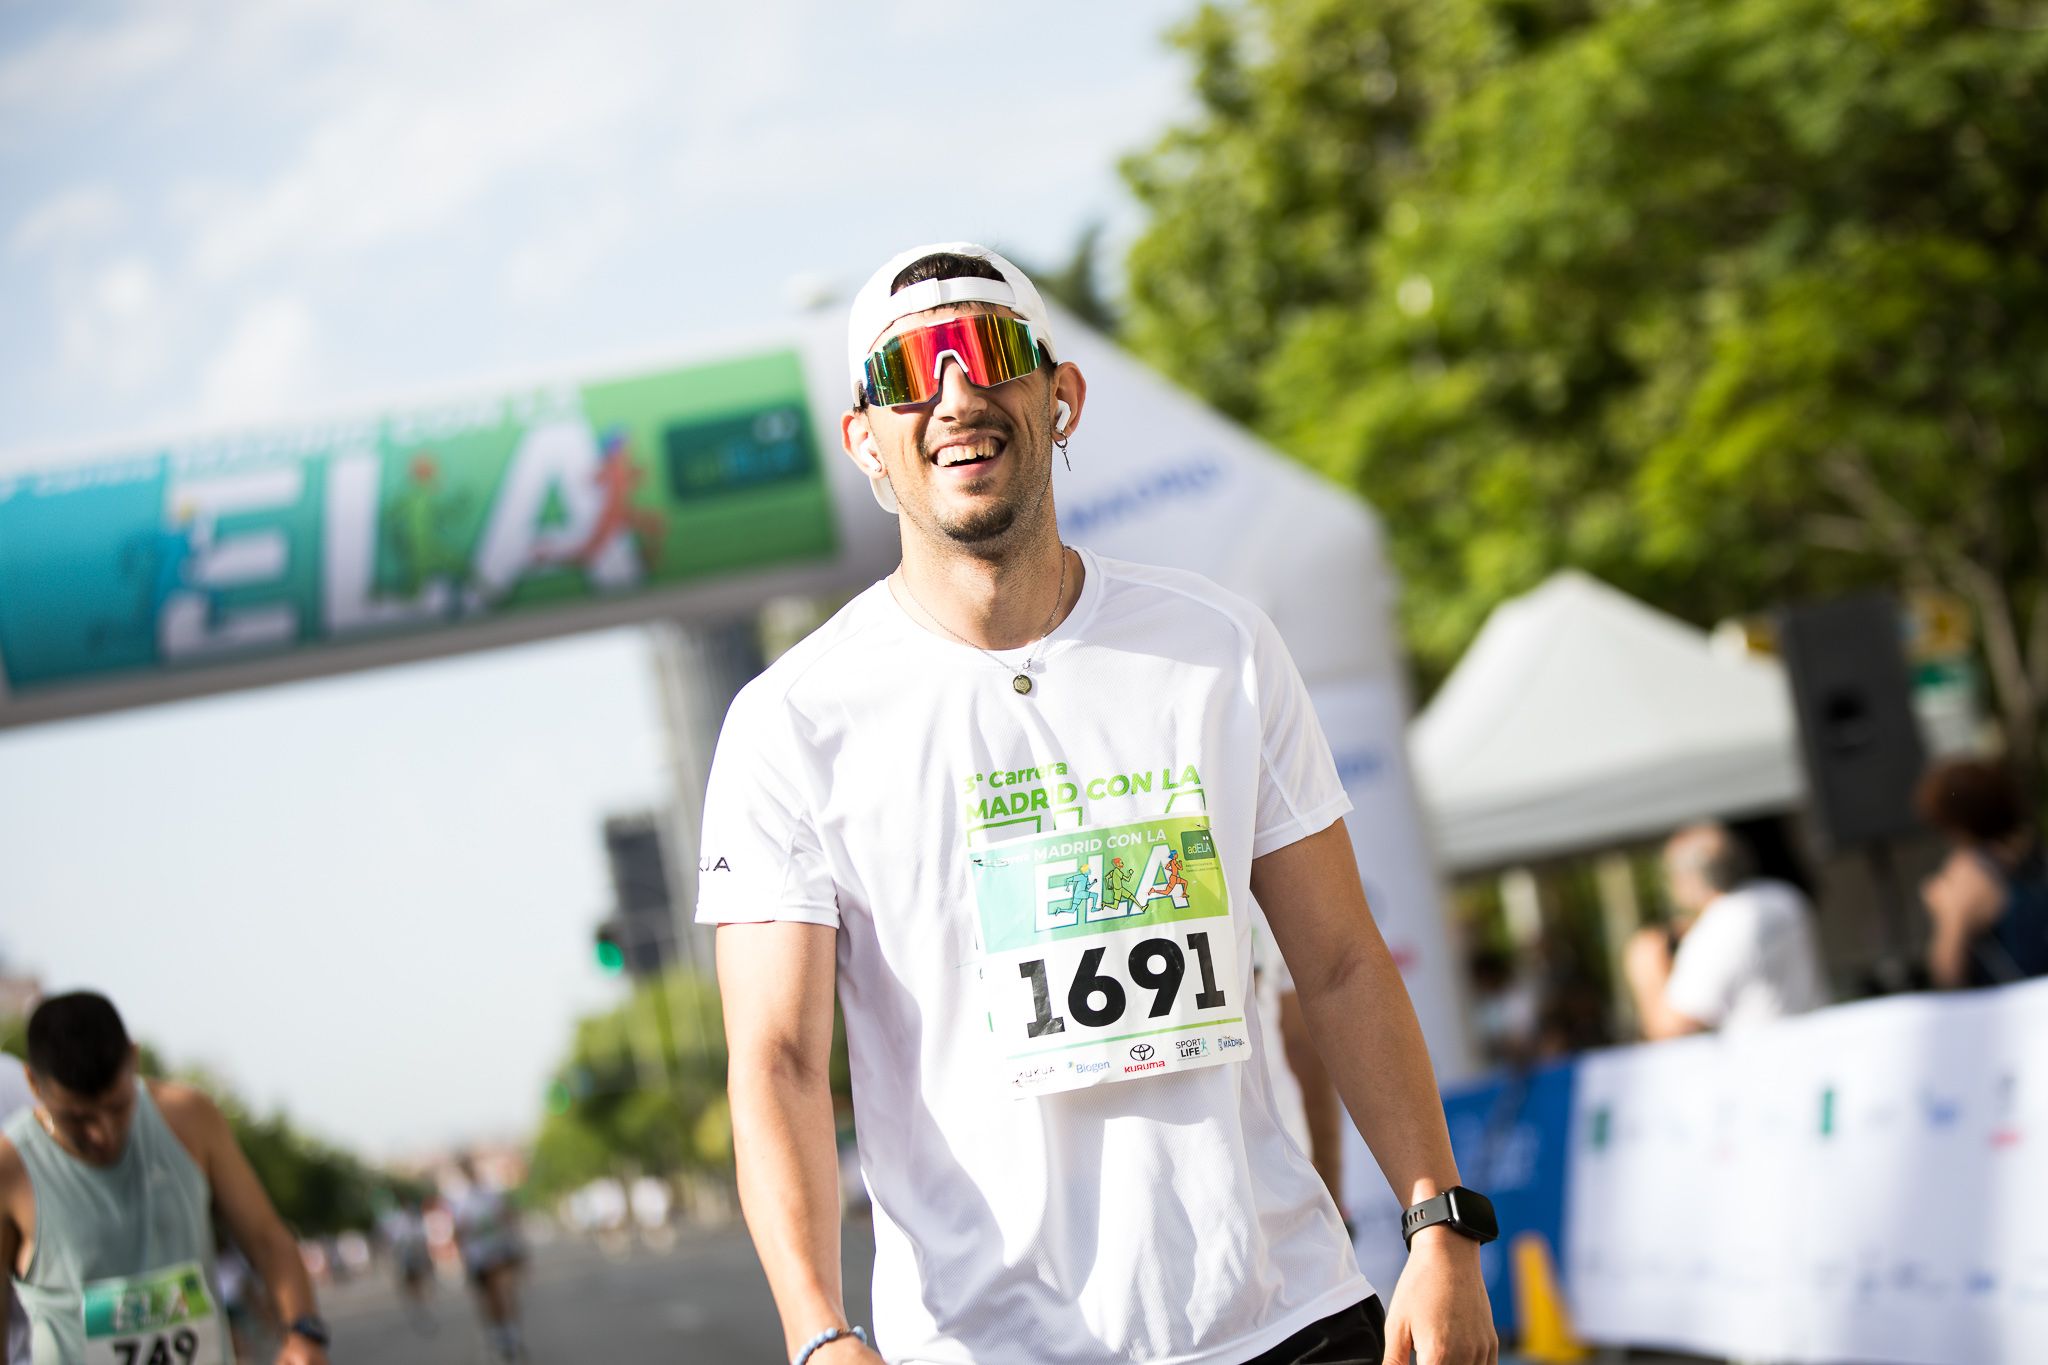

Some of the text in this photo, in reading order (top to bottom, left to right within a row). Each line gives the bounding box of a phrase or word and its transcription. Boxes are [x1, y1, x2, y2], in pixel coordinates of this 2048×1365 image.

[157, 418, 646, 657] ELA
[989, 762, 1067, 788] Carrera
[966, 765, 1201, 824] MADRID CON LA
[1034, 838, 1102, 861] MADRID
[1107, 832, 1142, 848] CON
[1147, 829, 1167, 844] LA
[1187, 843, 1212, 855] adELA
[1034, 843, 1190, 933] ELA
[1019, 932, 1226, 1038] 1691
[1175, 1038, 1201, 1050] SPORT
[1180, 1047, 1200, 1058] LIFE
[1076, 1061, 1111, 1073] Biogen
[113, 1328, 198, 1365] 749
